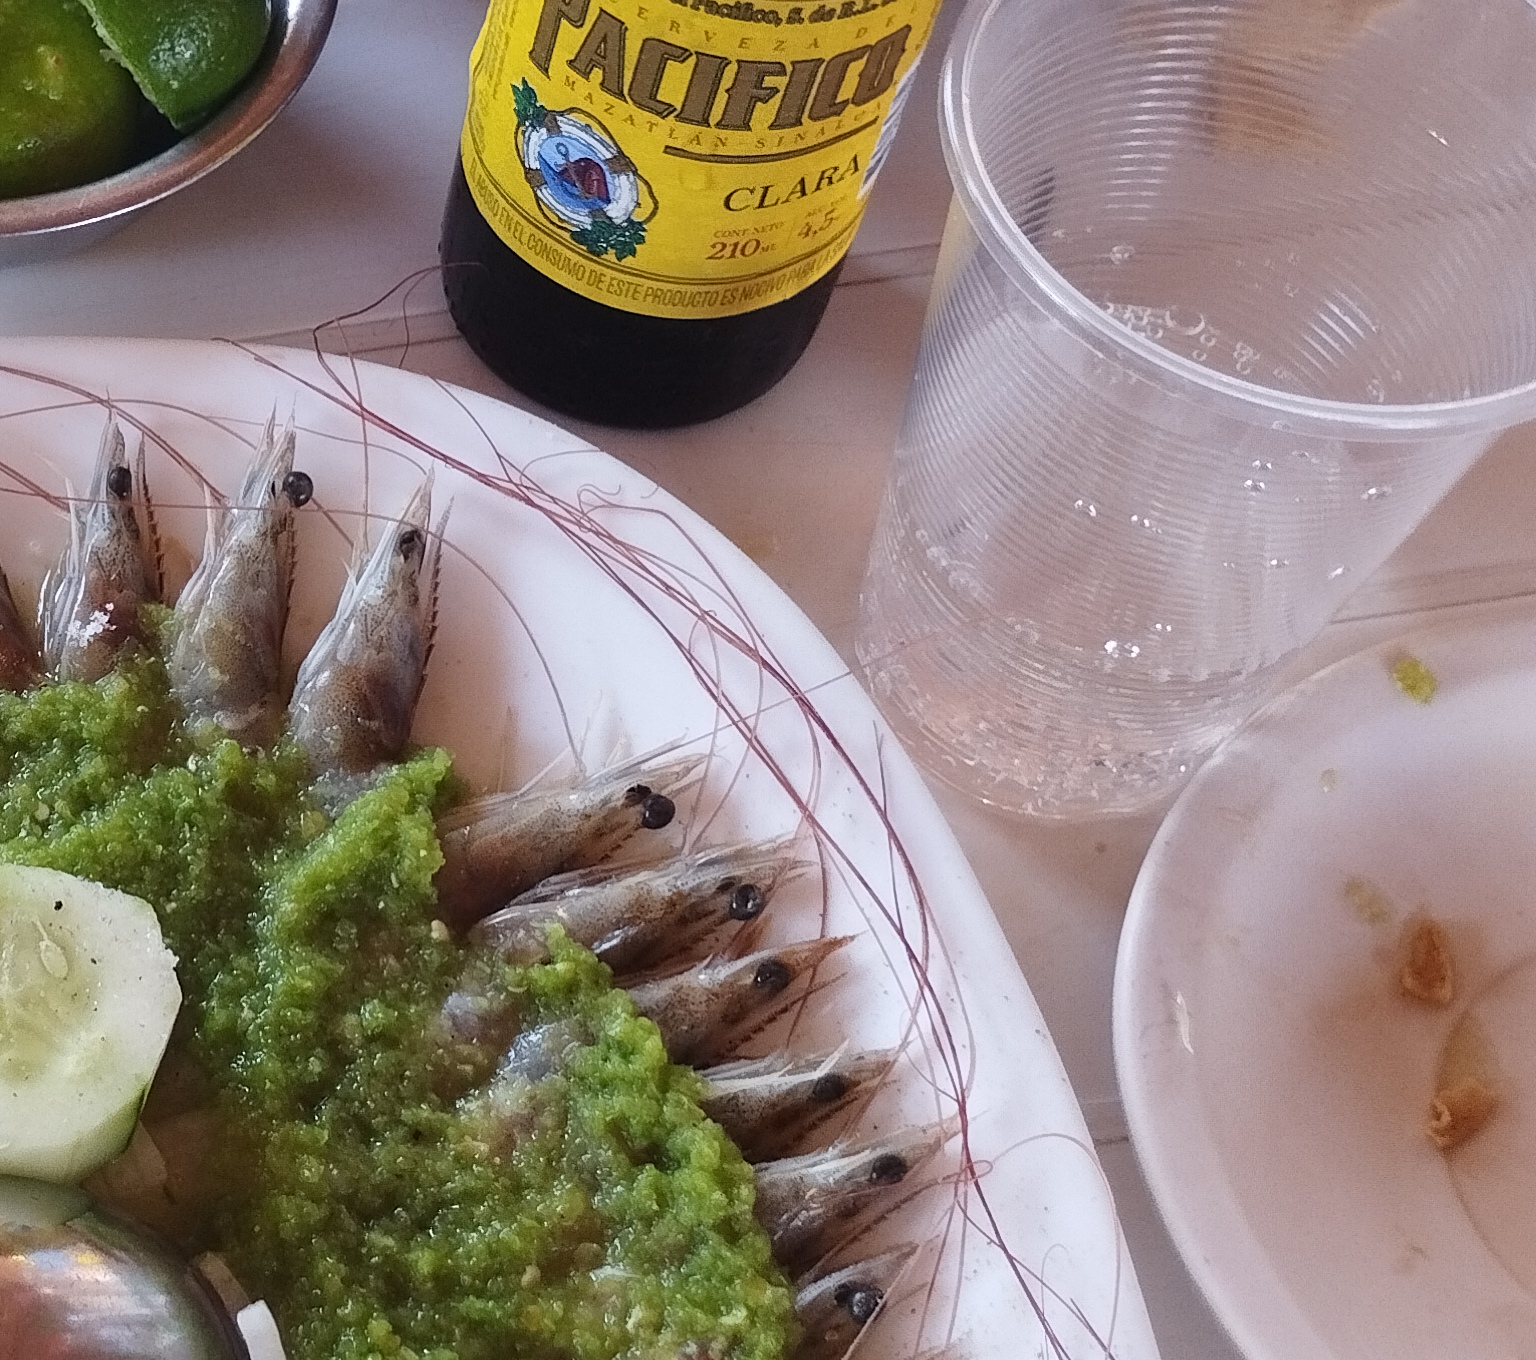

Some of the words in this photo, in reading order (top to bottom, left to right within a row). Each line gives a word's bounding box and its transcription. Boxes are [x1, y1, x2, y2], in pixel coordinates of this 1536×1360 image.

[808, 4, 837, 24] de
[723, 153, 860, 212] CLARA
[499, 207, 513, 232] EN
[526, 233, 586, 282] CONSUMO
[586, 269, 606, 291] DE
[606, 276, 644, 301] ESTE
[643, 286, 718, 308] PRODUCTO
[721, 288, 738, 306] ES
